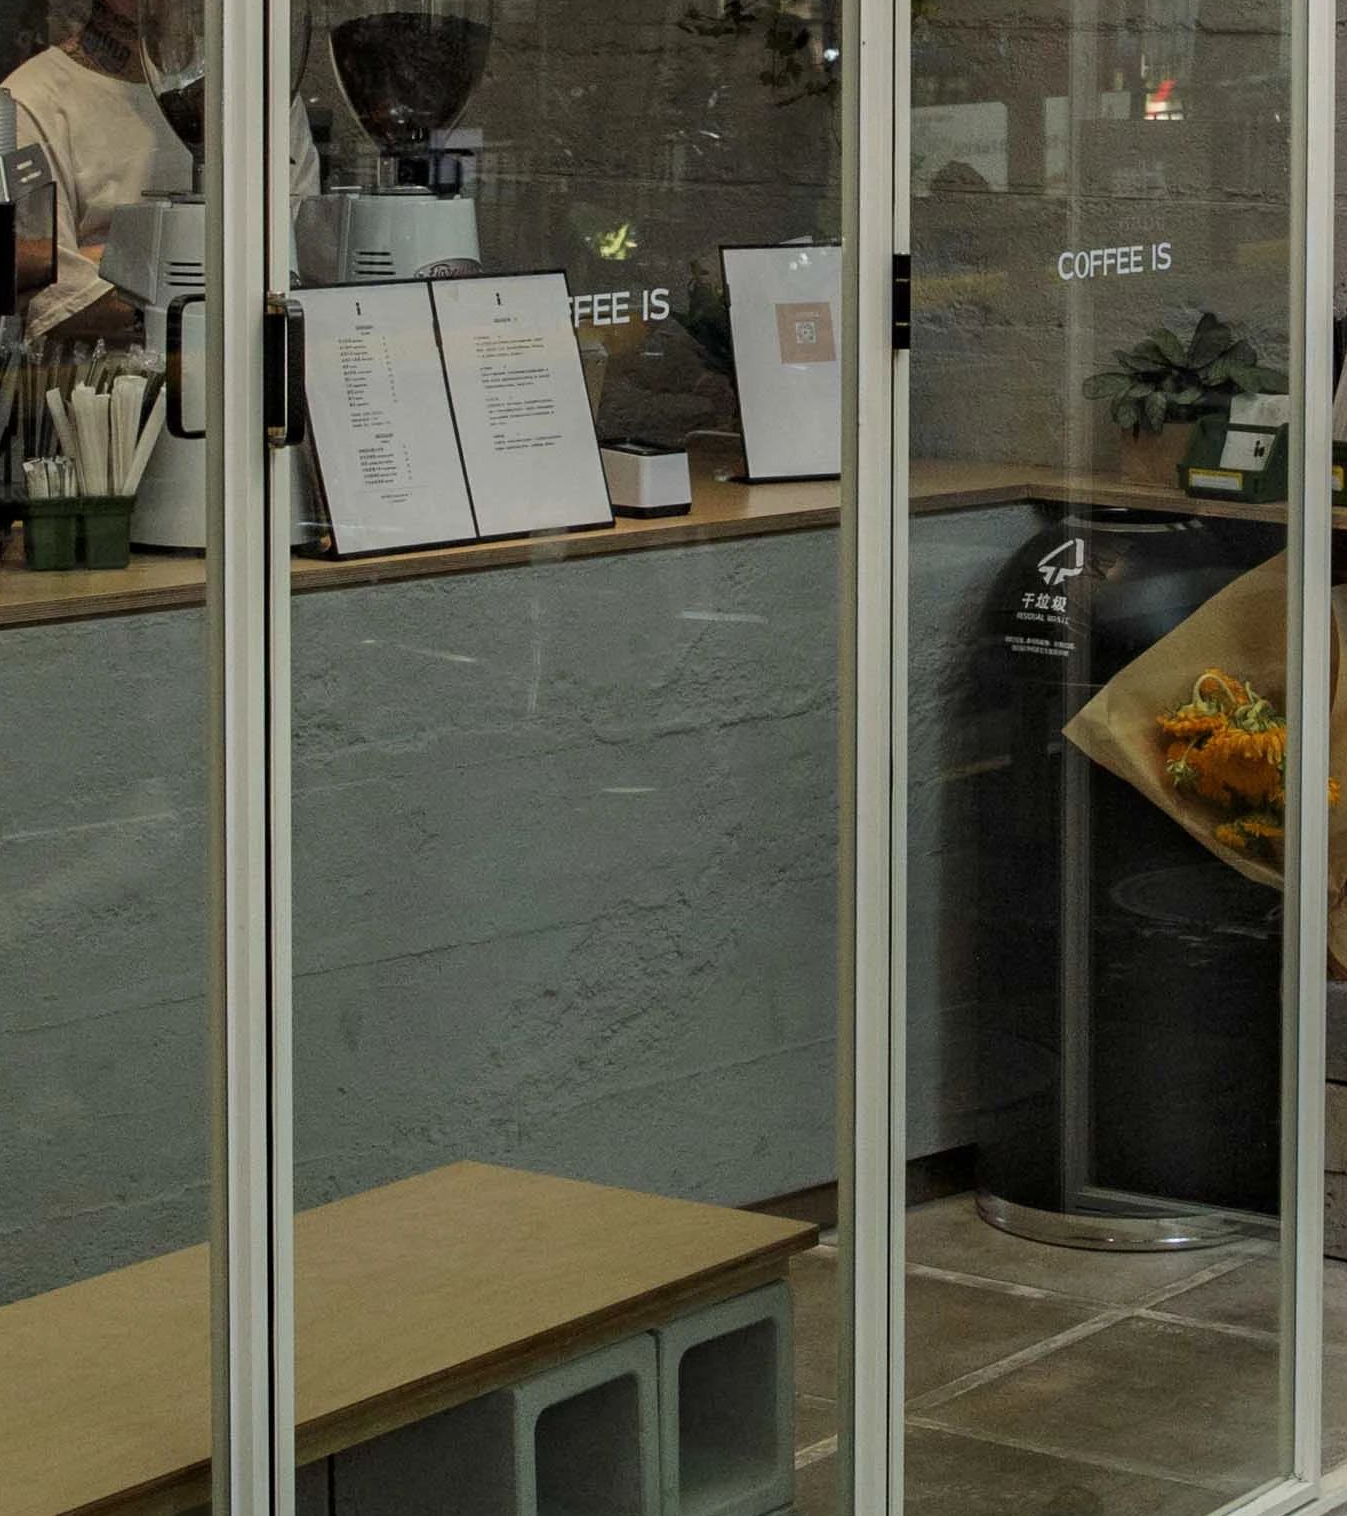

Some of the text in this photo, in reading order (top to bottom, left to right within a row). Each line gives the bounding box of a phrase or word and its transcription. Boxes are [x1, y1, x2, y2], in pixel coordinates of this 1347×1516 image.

[1057, 241, 1173, 281] COFFEE IS
[567, 287, 670, 329] FEE IS
[1021, 592, 1069, 614] 干垃圾
